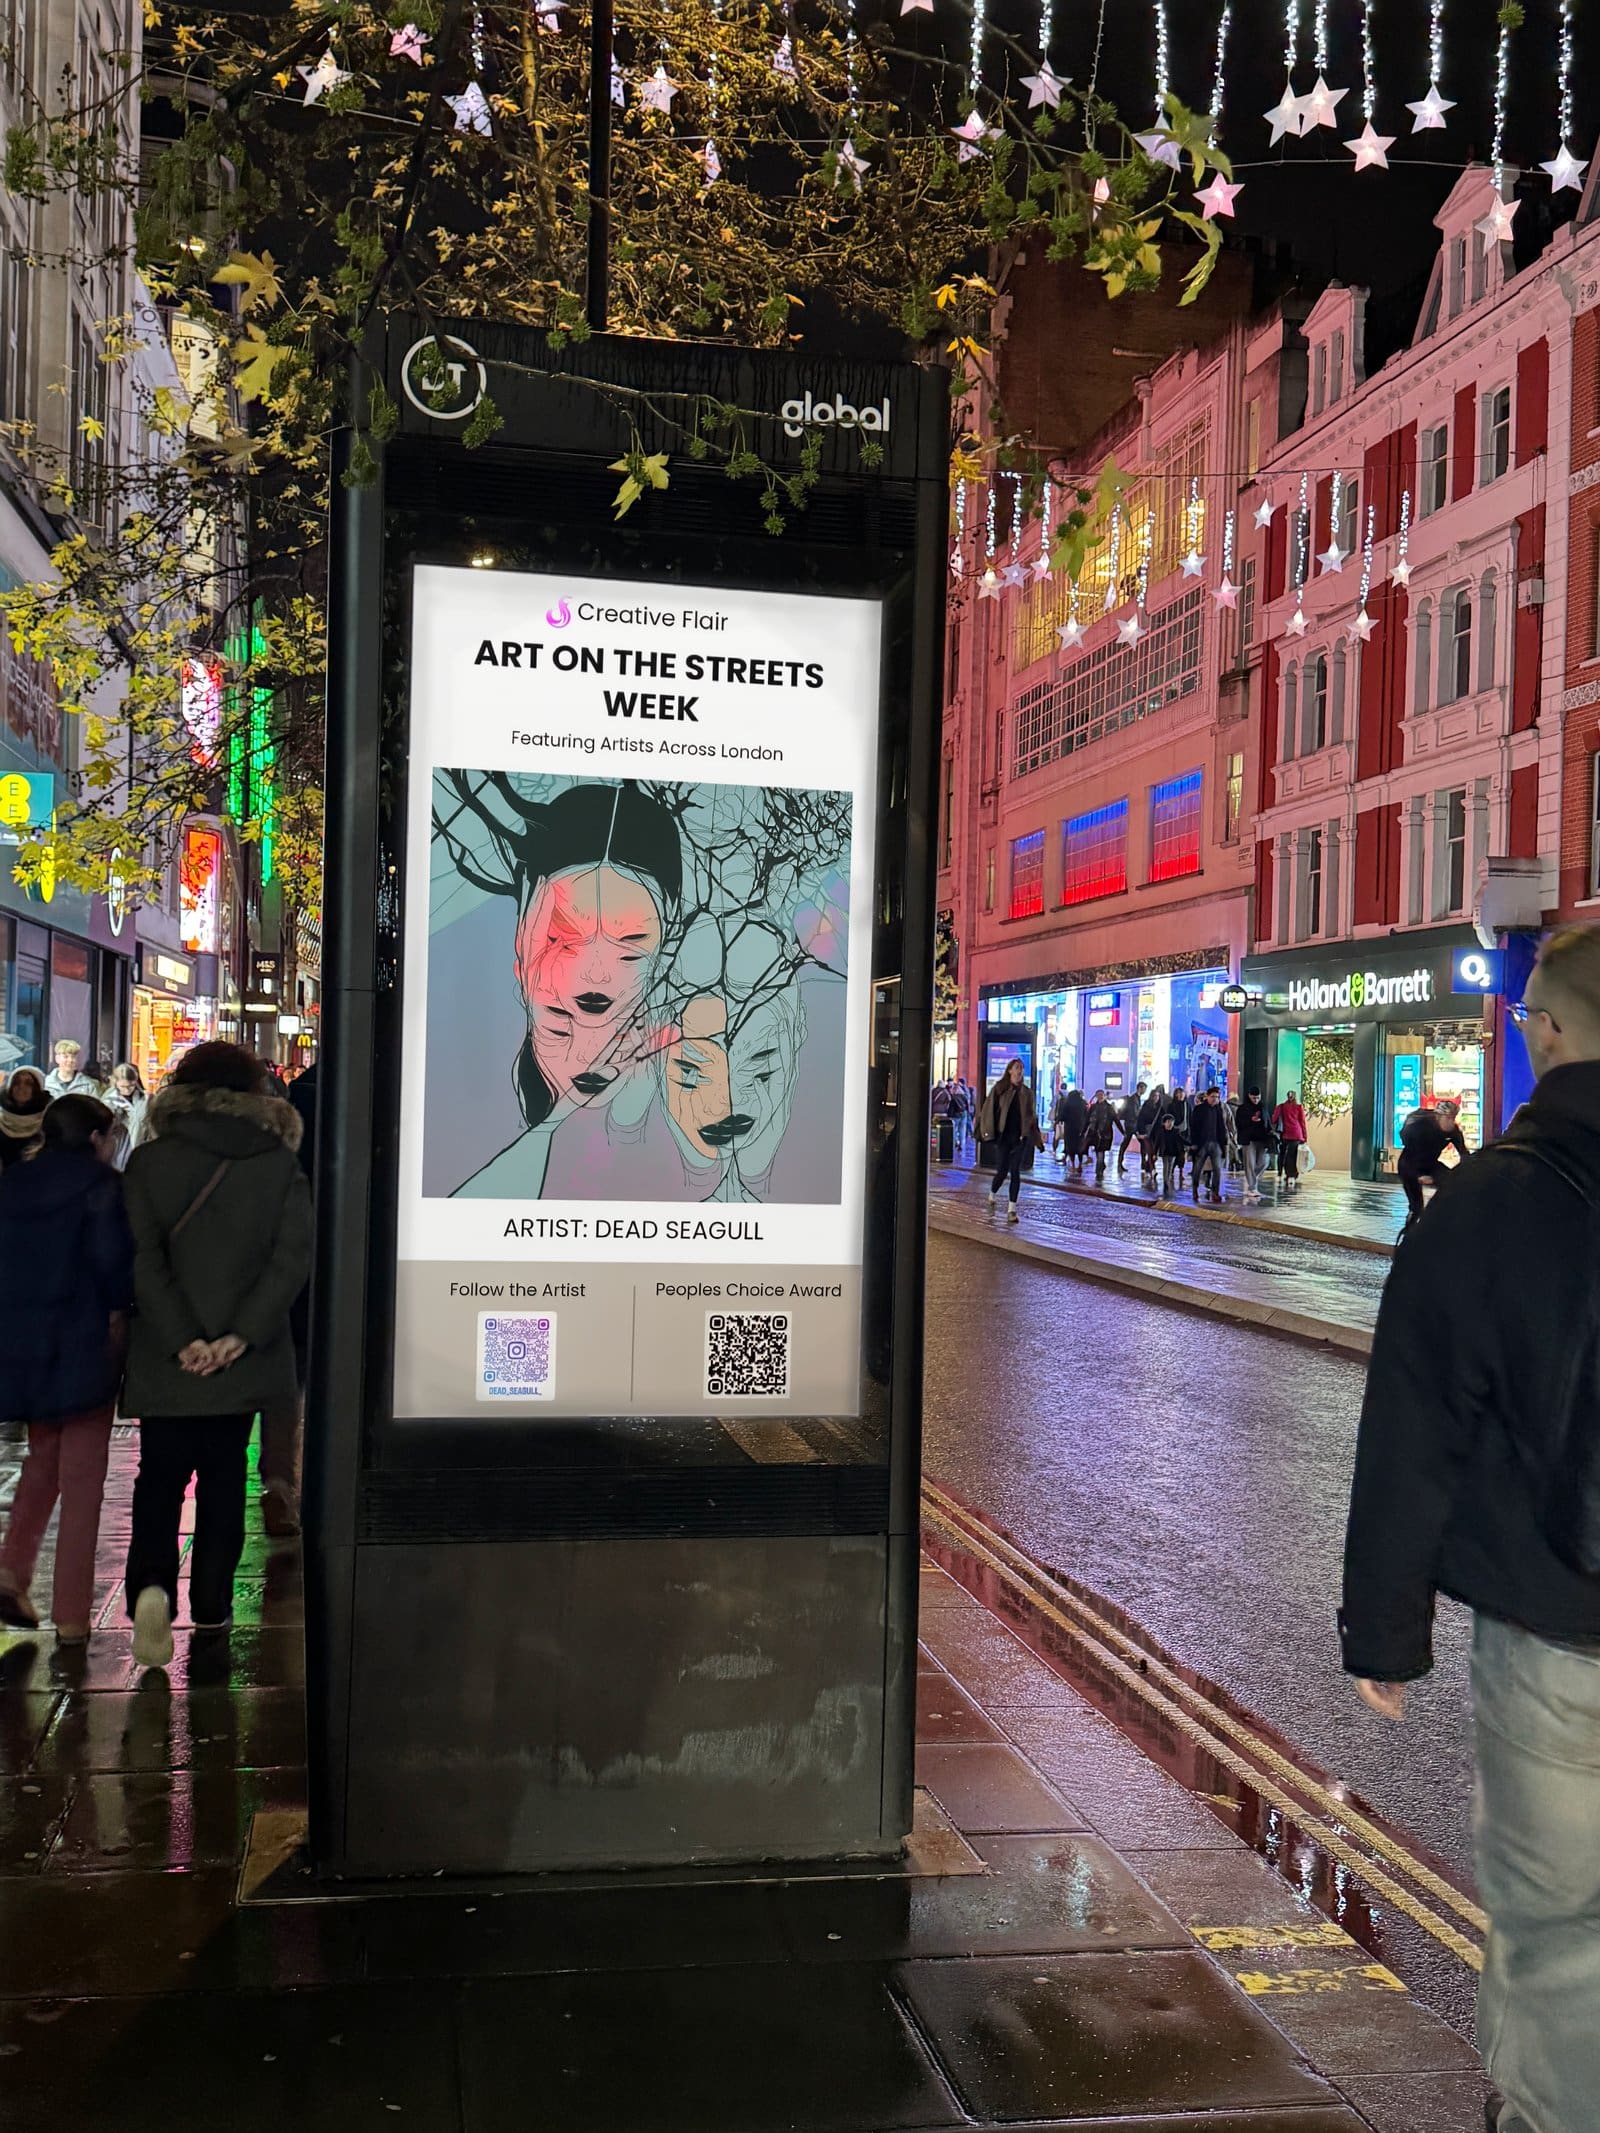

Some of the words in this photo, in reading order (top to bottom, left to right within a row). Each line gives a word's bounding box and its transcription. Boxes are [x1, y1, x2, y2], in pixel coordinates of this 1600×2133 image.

[782, 391, 889, 436] global
[578, 603, 675, 626] Creative
[683, 611, 728, 631] Flair
[474, 640, 543, 668] ART
[553, 645, 604, 673] ON
[614, 649, 676, 678] THE
[686, 655, 823, 688] STREETS
[603, 691, 699, 722] WEEK
[512, 731, 594, 753] Featuring
[601, 737, 653, 752] Artists
[659, 741, 715, 756] Across
[722, 744, 782, 761] London
[9, 782, 22, 818] EE
[1289, 974, 1350, 1011] Holland
[1364, 969, 1430, 1006] Barrett
[504, 1219, 587, 1237] ARTIST:
[596, 1220, 657, 1238] DEAD
[666, 1221, 763, 1240] SEAGULL
[451, 1283, 504, 1296] Follow
[509, 1283, 537, 1296] the
[542, 1283, 585, 1296] Artist
[656, 1283, 721, 1300] Peoples
[727, 1283, 784, 1296] Choice
[789, 1284, 841, 1297] Award
